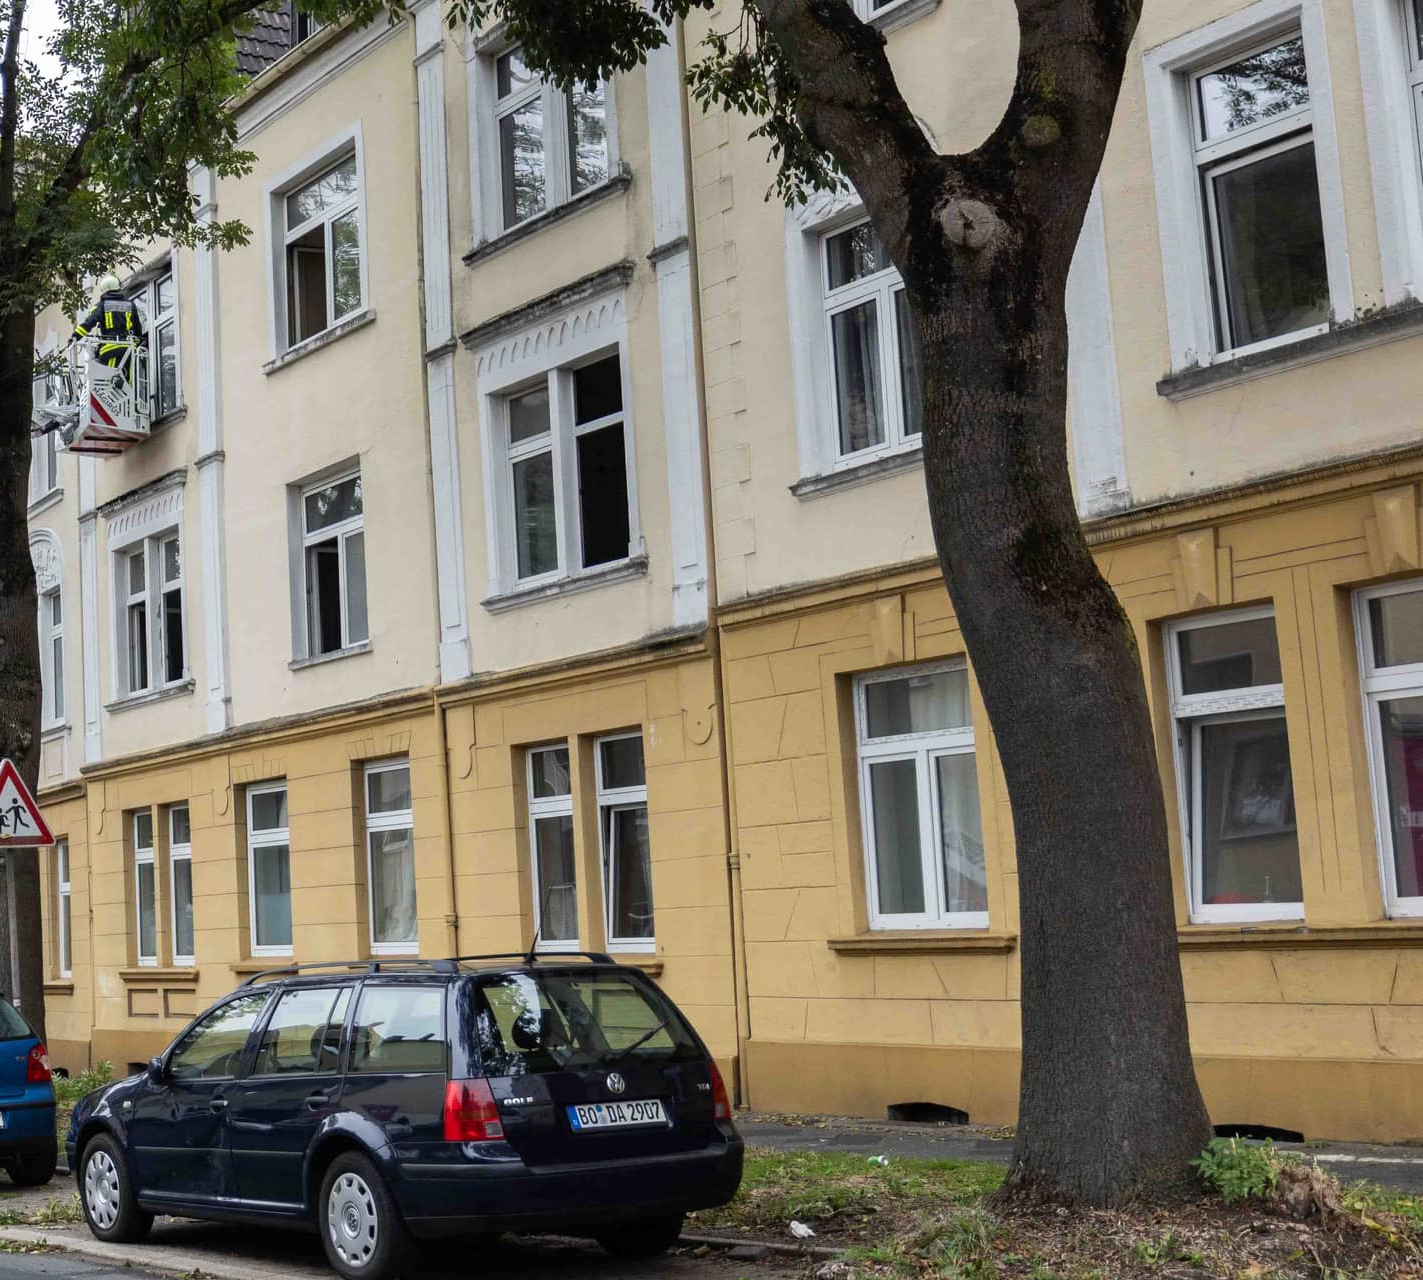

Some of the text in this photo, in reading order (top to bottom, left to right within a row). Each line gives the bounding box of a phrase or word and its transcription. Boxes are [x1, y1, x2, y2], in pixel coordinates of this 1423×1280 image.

[92, 387, 119, 416] MAGIRUS
[503, 1096, 534, 1105] GOLF
[577, 1102, 660, 1126] BO DA 2907
